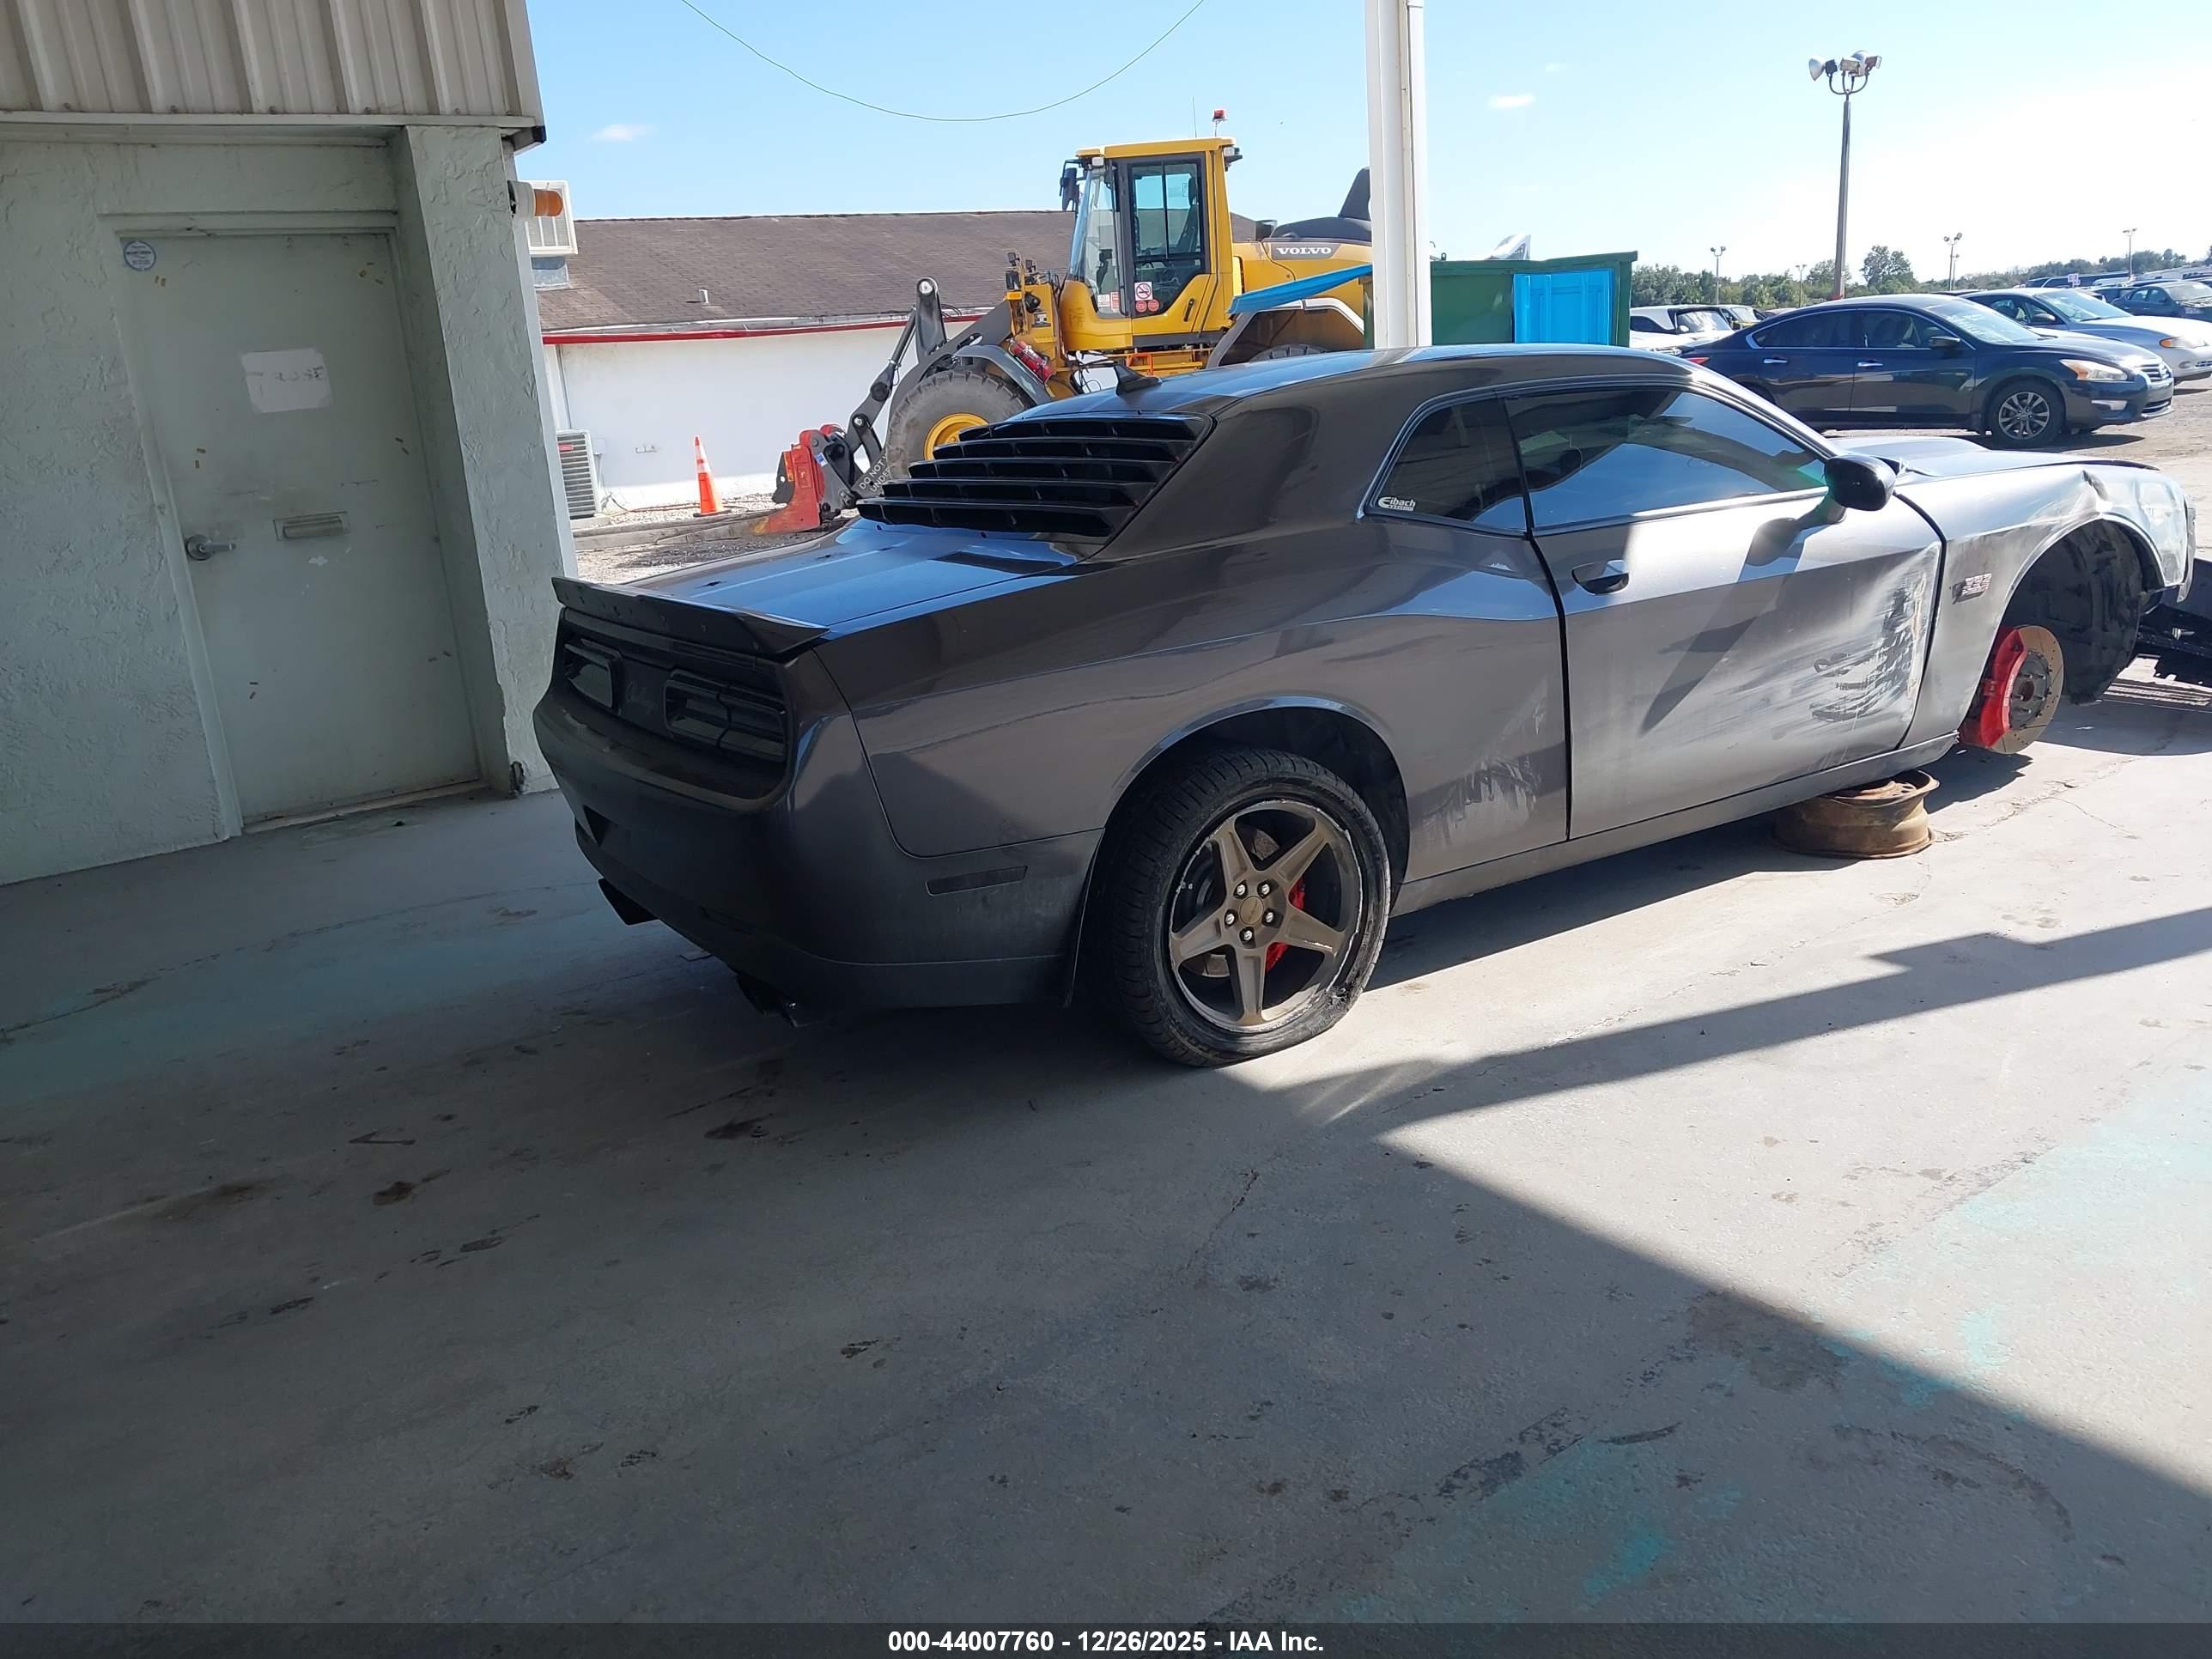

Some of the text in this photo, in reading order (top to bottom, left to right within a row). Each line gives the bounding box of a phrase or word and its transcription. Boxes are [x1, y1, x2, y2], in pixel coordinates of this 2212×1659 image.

[1276, 246, 1332, 255] VOLVO
[859, 459, 885, 489] DO NOT
[1378, 497, 1416, 508] Eibach
